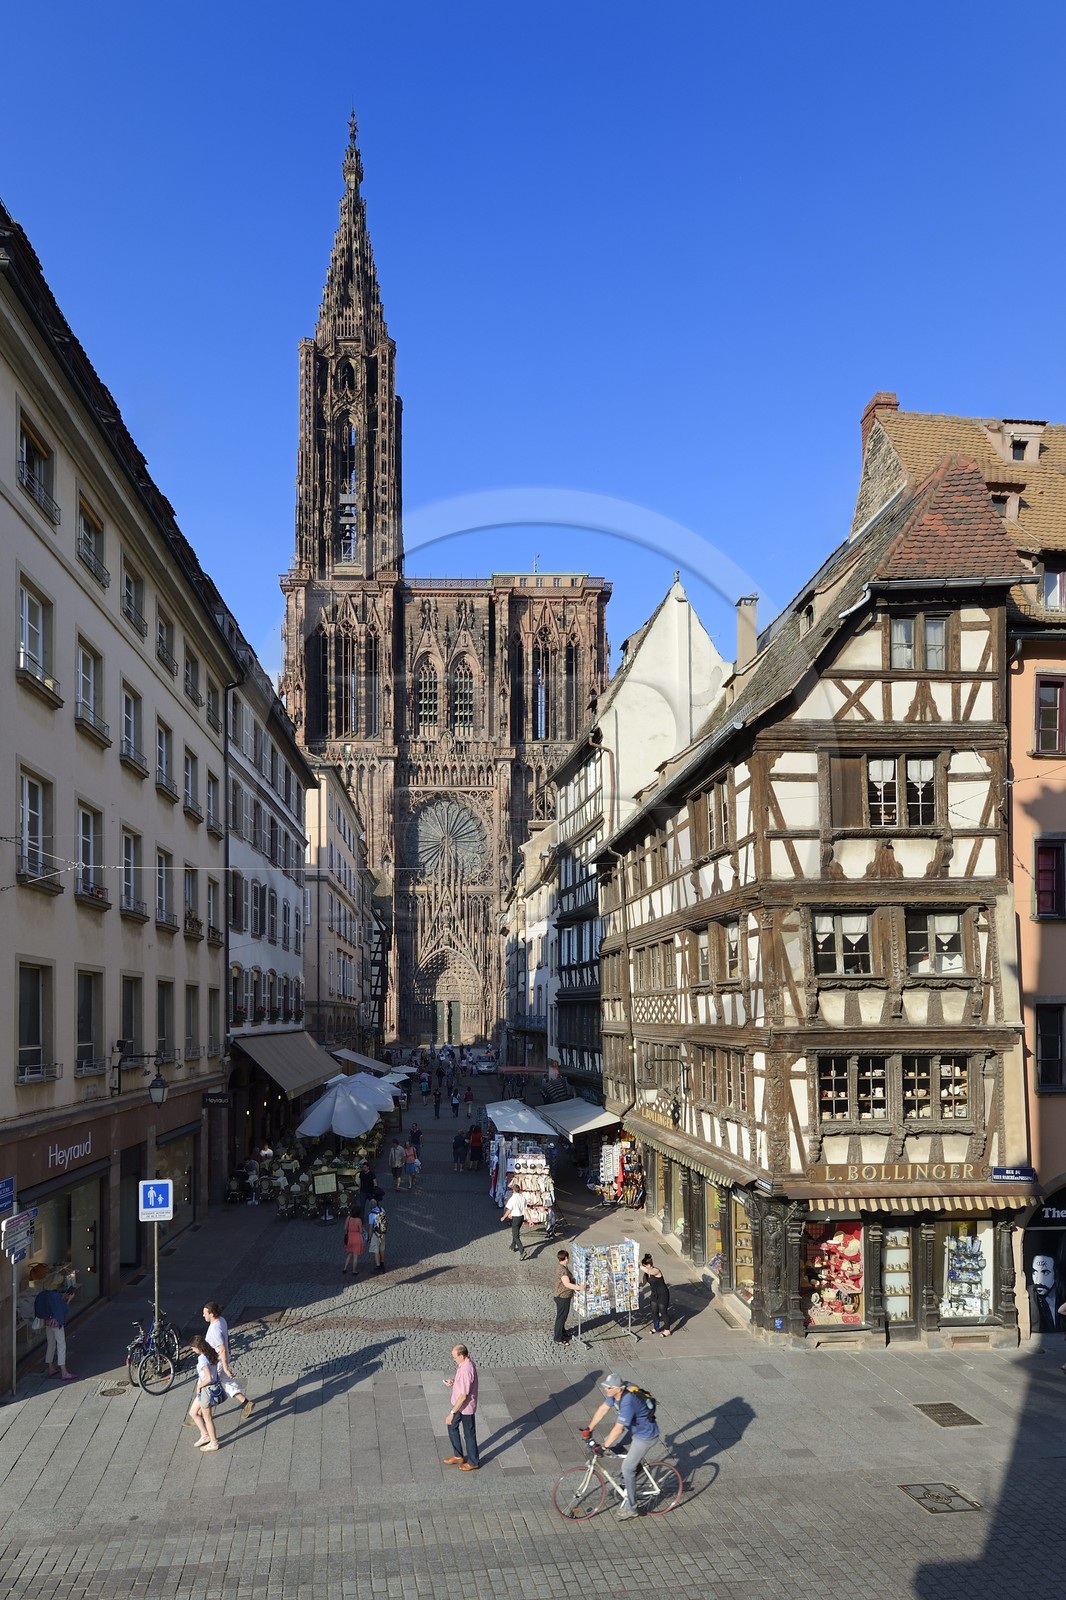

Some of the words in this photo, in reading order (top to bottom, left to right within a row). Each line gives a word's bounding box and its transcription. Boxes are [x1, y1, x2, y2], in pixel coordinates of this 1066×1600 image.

[48, 1131, 92, 1170] Heyraud
[825, 1165, 843, 1181] L.
[847, 1164, 974, 1181] BOLLINGER
[1041, 1207, 1066, 1219] The
